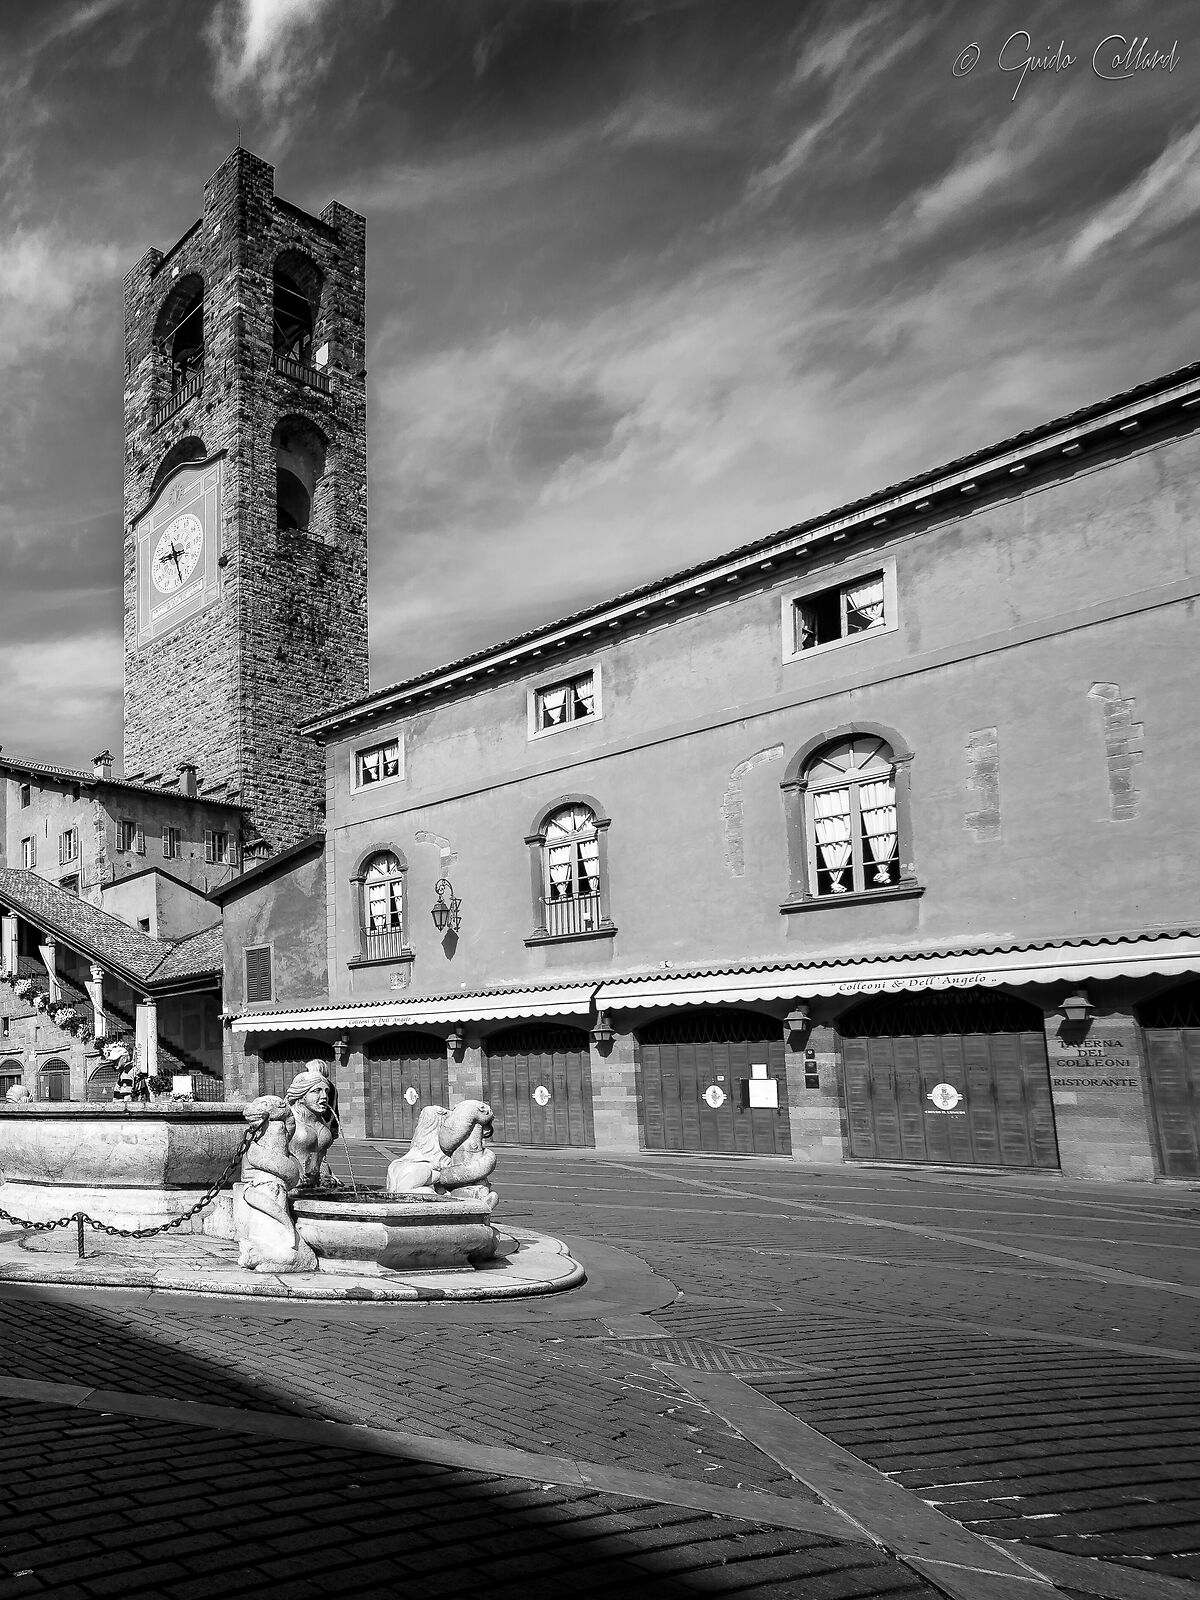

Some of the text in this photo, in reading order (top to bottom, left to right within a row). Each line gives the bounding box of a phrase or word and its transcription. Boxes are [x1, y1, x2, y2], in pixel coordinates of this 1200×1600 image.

[891, 979, 904, 989] &
[1077, 1049, 1107, 1057] DEL
[1056, 1059, 1130, 1067] COLLEONI
[1053, 1079, 1138, 1087] RISTORANTE
